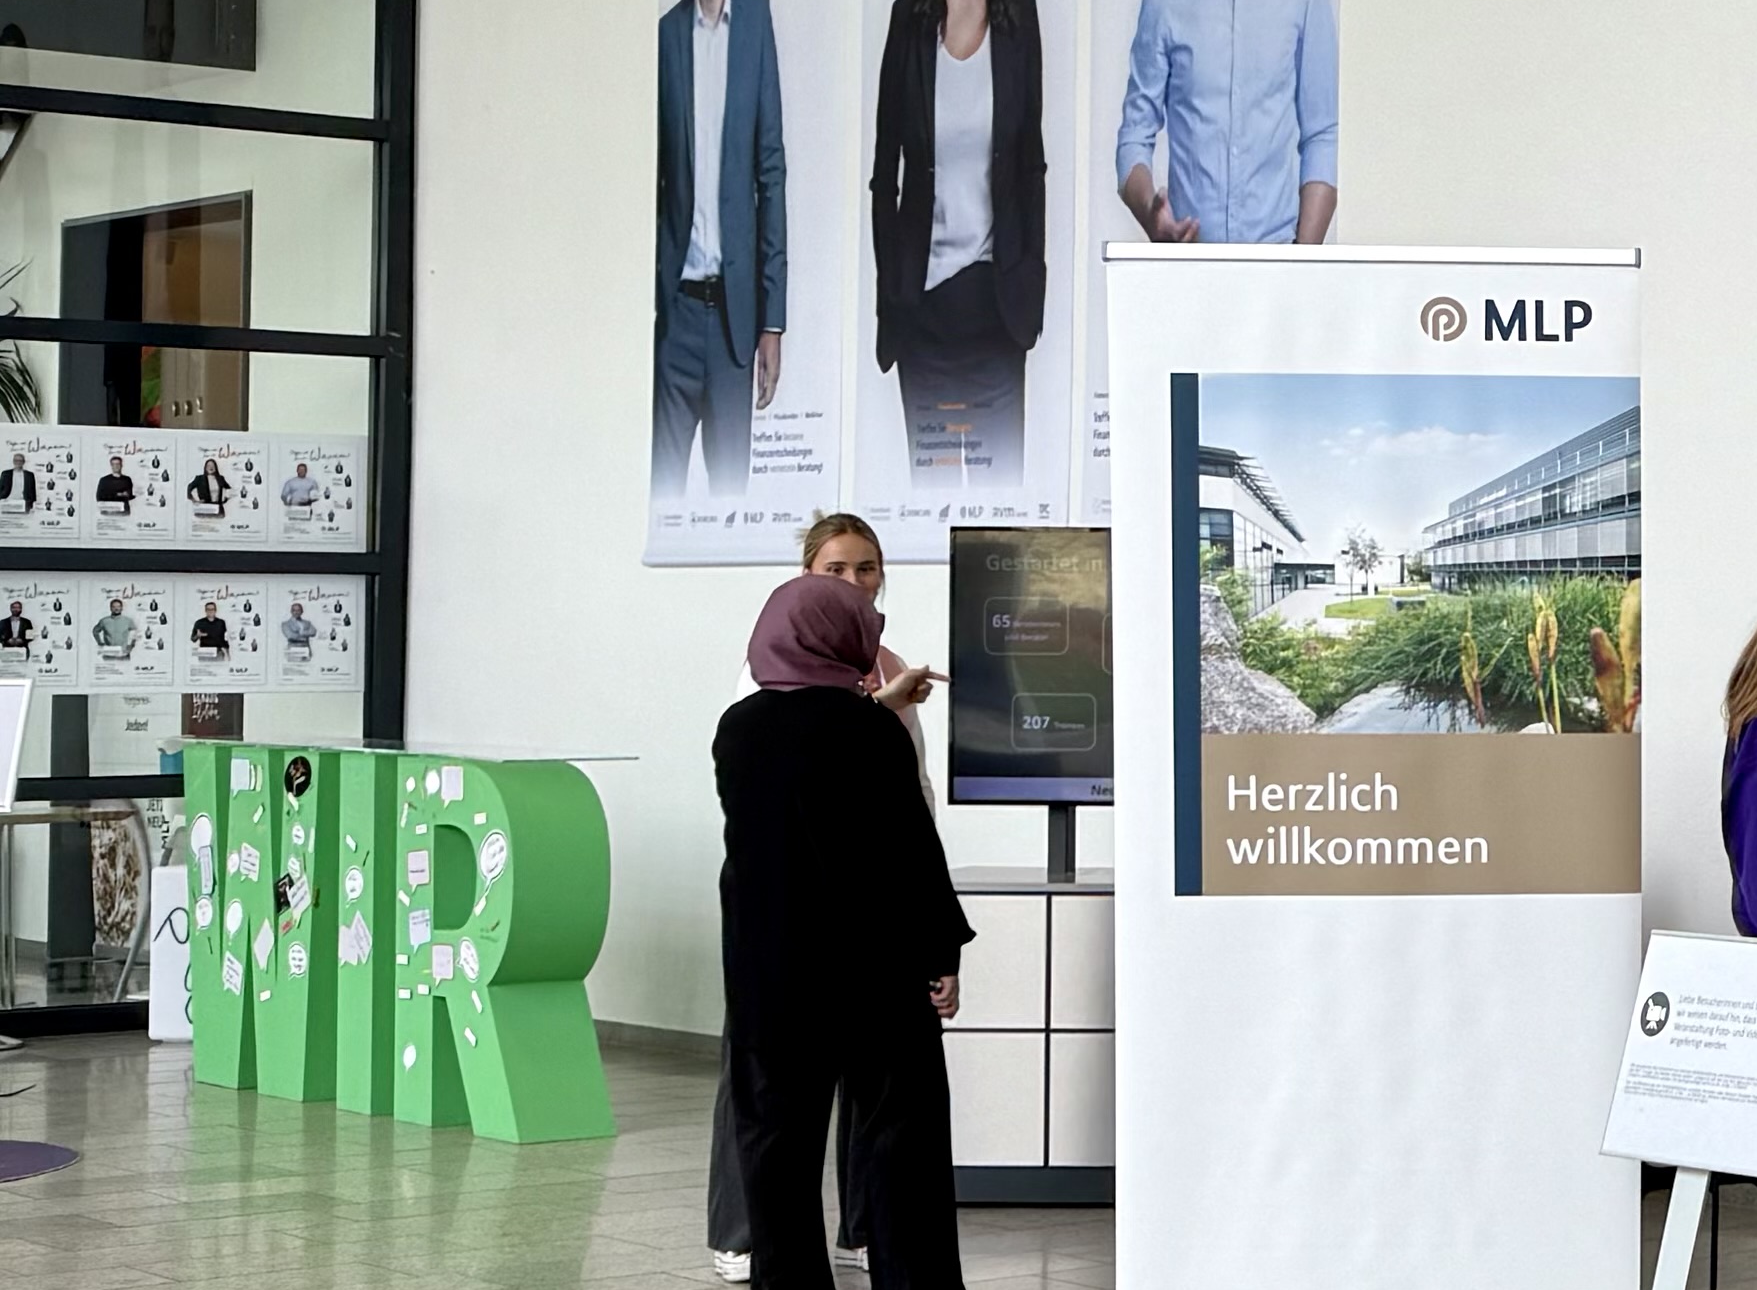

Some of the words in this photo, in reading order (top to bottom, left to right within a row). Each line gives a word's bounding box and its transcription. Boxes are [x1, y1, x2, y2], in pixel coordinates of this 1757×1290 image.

[1485, 299, 1593, 342] MLP
[986, 554, 1079, 572] Gestartet
[992, 614, 1010, 628] 65
[1022, 715, 1050, 729] 207
[1227, 772, 1398, 812] Herzlich
[1226, 825, 1489, 865] willkommen
[184, 743, 613, 1144] WIR
